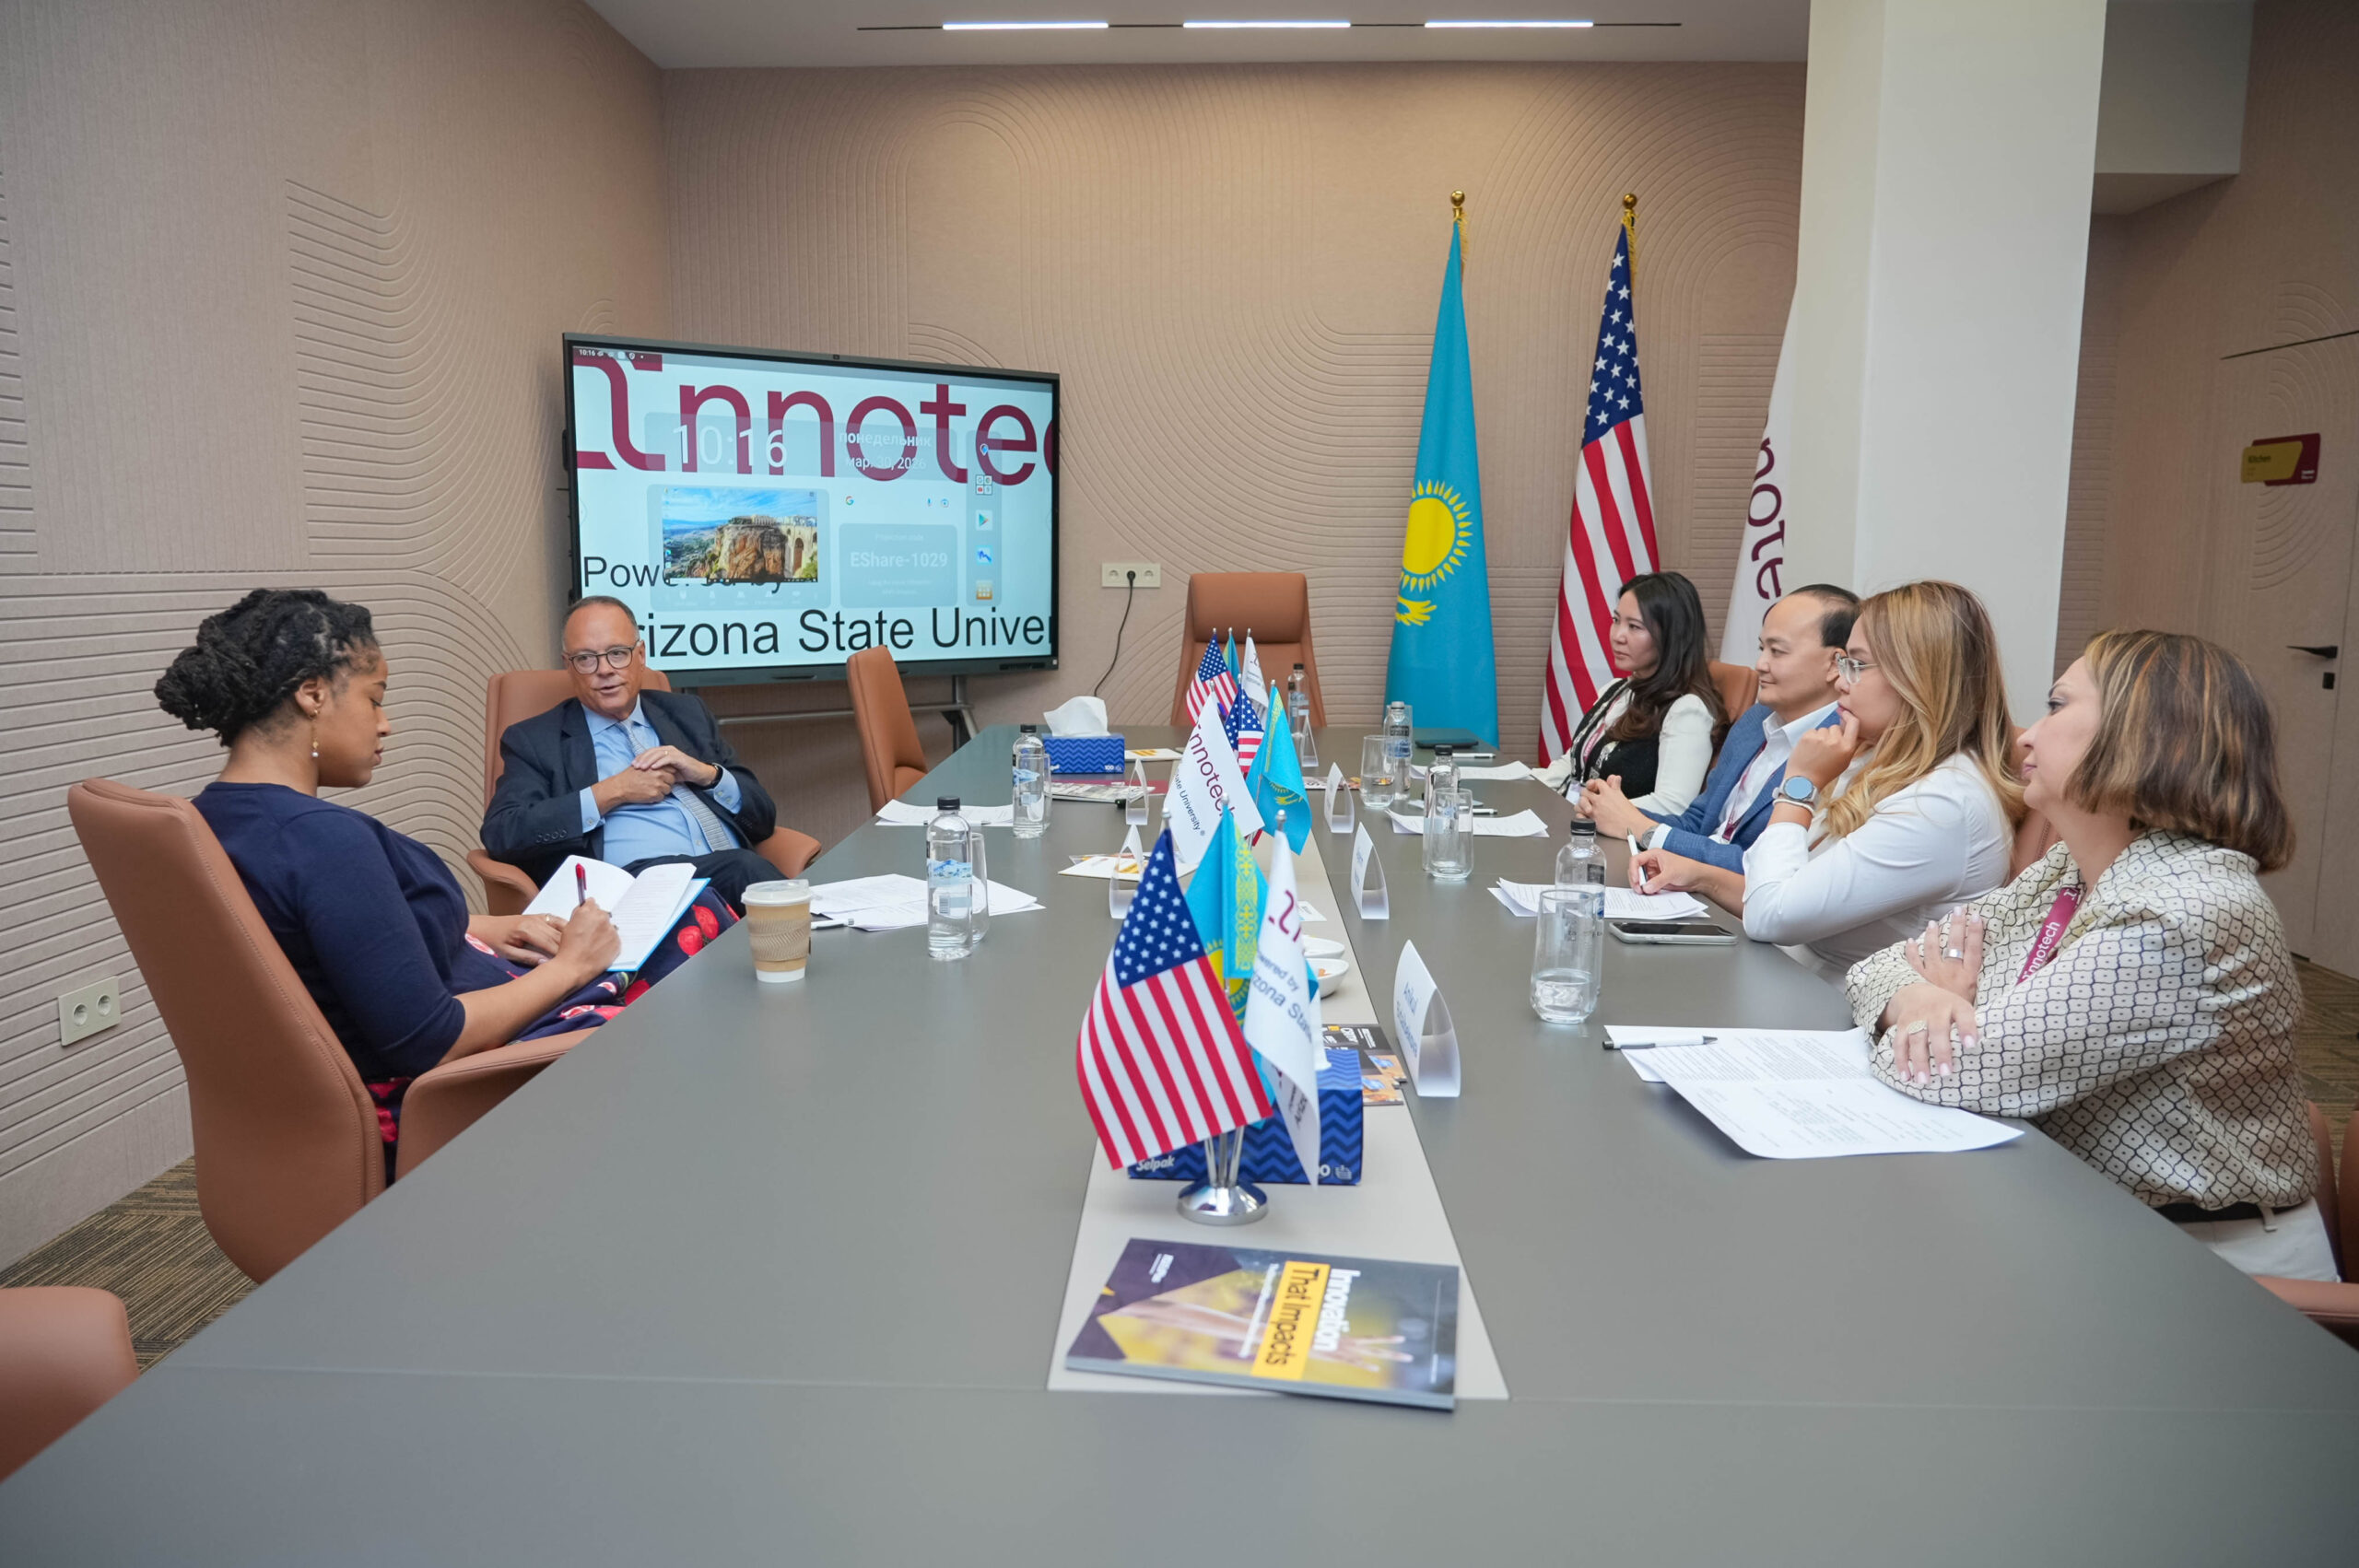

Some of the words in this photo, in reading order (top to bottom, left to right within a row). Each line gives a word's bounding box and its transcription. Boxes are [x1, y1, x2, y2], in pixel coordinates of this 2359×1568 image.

[572, 349, 1053, 486] Innote
[673, 424, 788, 468] 10:16
[850, 551, 948, 568] EShare-1029
[638, 613, 780, 658] izona
[799, 608, 914, 652] State
[933, 606, 1052, 649] Unive
[1180, 790, 1201, 831] University
[1257, 950, 1288, 980] wered
[1251, 970, 1286, 1008] zona
[1285, 1269, 1320, 1300] That
[1312, 1269, 1361, 1352] Innovation
[1265, 1302, 1311, 1365] Impacts
